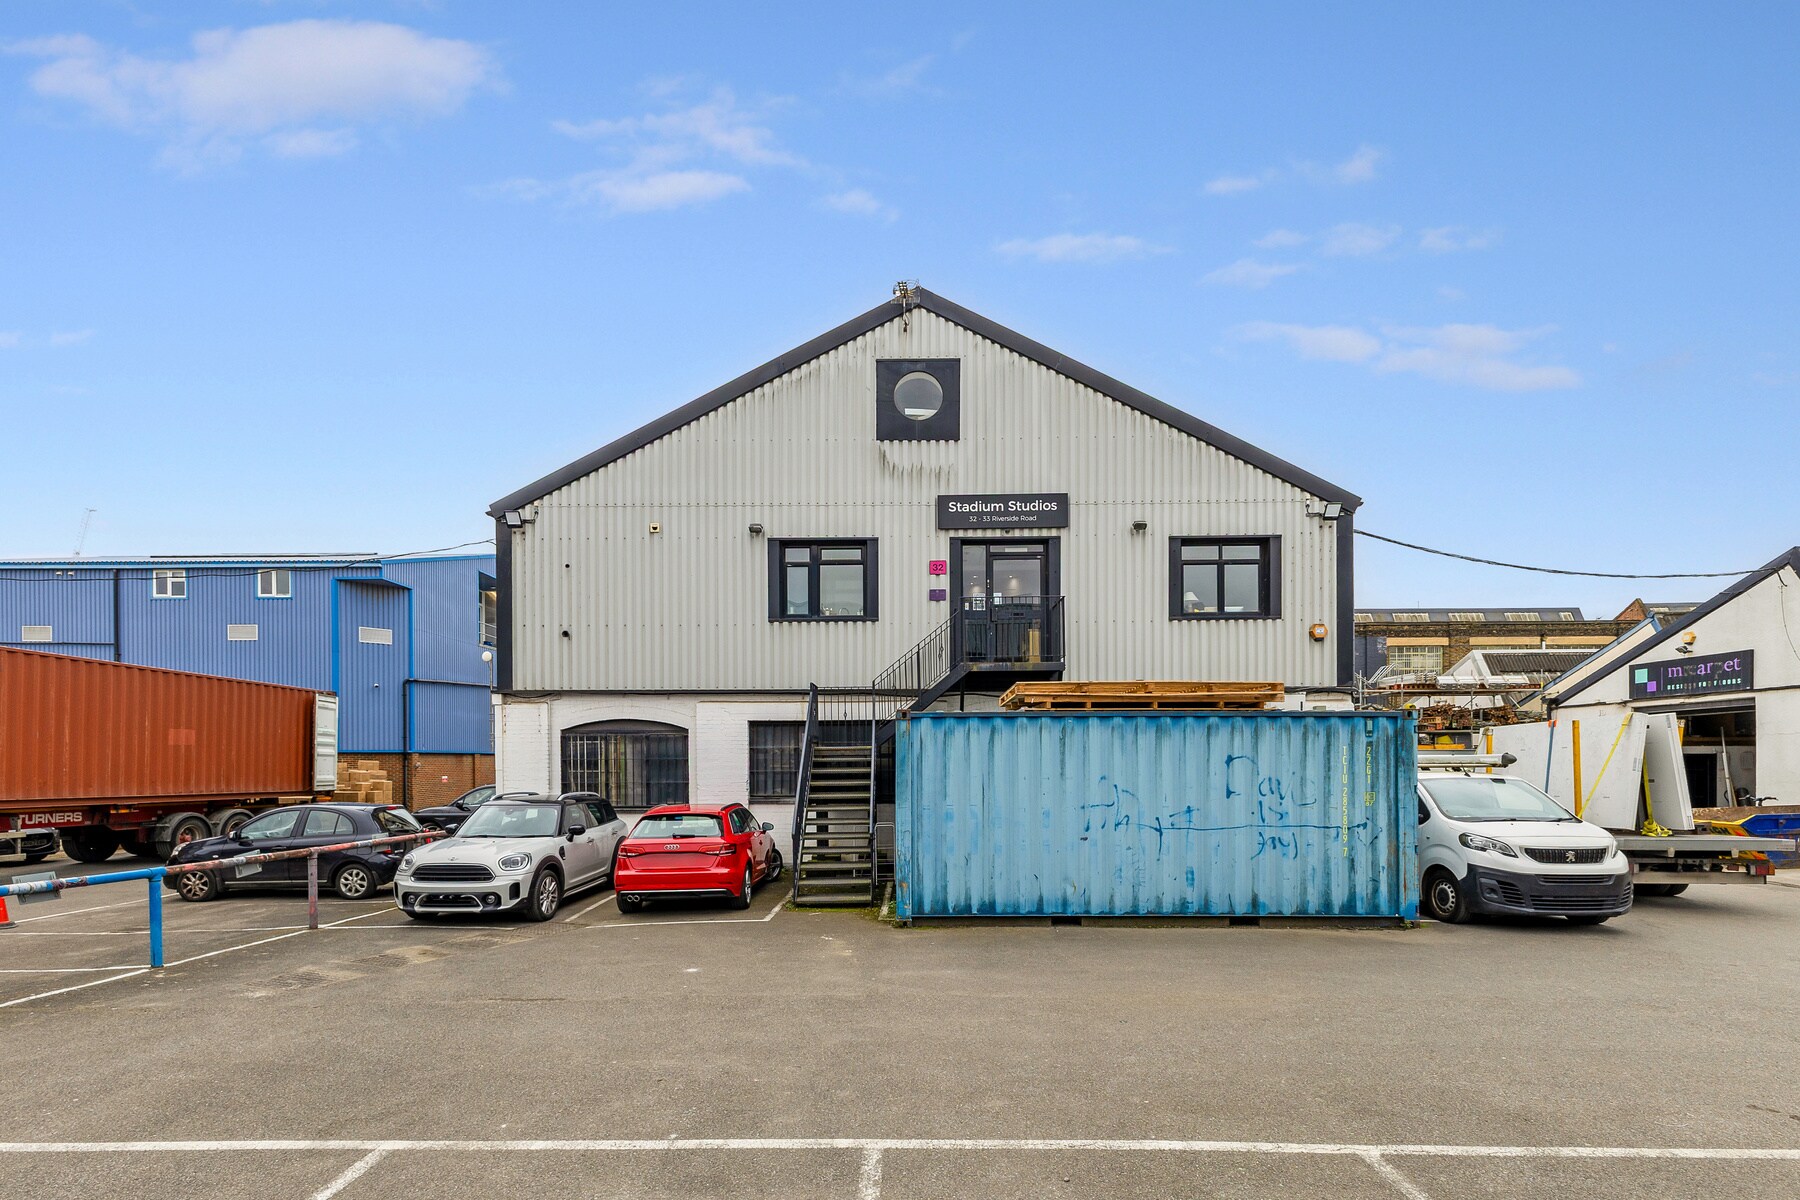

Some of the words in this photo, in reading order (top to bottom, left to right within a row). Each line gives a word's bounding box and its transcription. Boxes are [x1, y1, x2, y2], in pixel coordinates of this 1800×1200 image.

[948, 500, 1004, 513] Stadium
[1008, 500, 1058, 511] Studios
[932, 563, 944, 572] 32
[19, 811, 83, 825] TURNERS
[1342, 847, 1348, 857] 7
